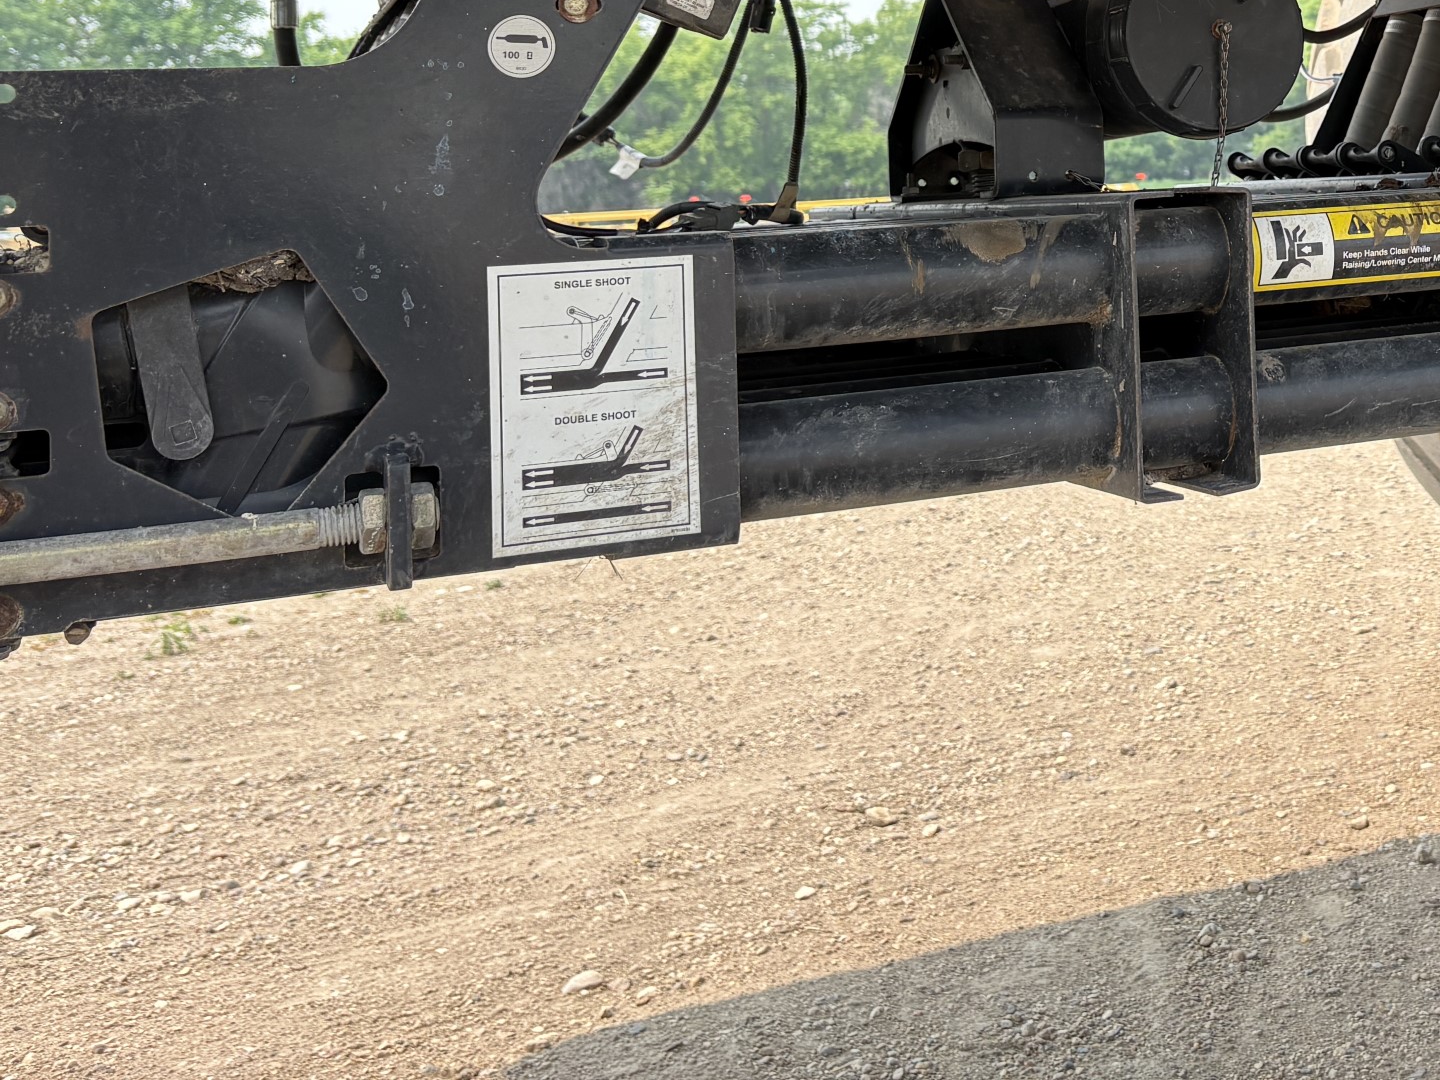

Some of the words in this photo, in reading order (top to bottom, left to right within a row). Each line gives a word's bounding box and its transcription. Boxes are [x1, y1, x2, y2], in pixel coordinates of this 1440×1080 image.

[502, 51, 520, 59] 100
[1343, 250, 1362, 260] Keep
[1364, 248, 1388, 258] Hands
[1389, 247, 1409, 255] Clear
[1411, 245, 1431, 254] While
[1342, 258, 1406, 269] Raising/Lowering
[1407, 255, 1431, 264] Center
[554, 278, 593, 290] SINGLE
[595, 276, 632, 287] SHOOT
[554, 413, 598, 425] DOUBLE
[601, 410, 637, 422] SHOOT
